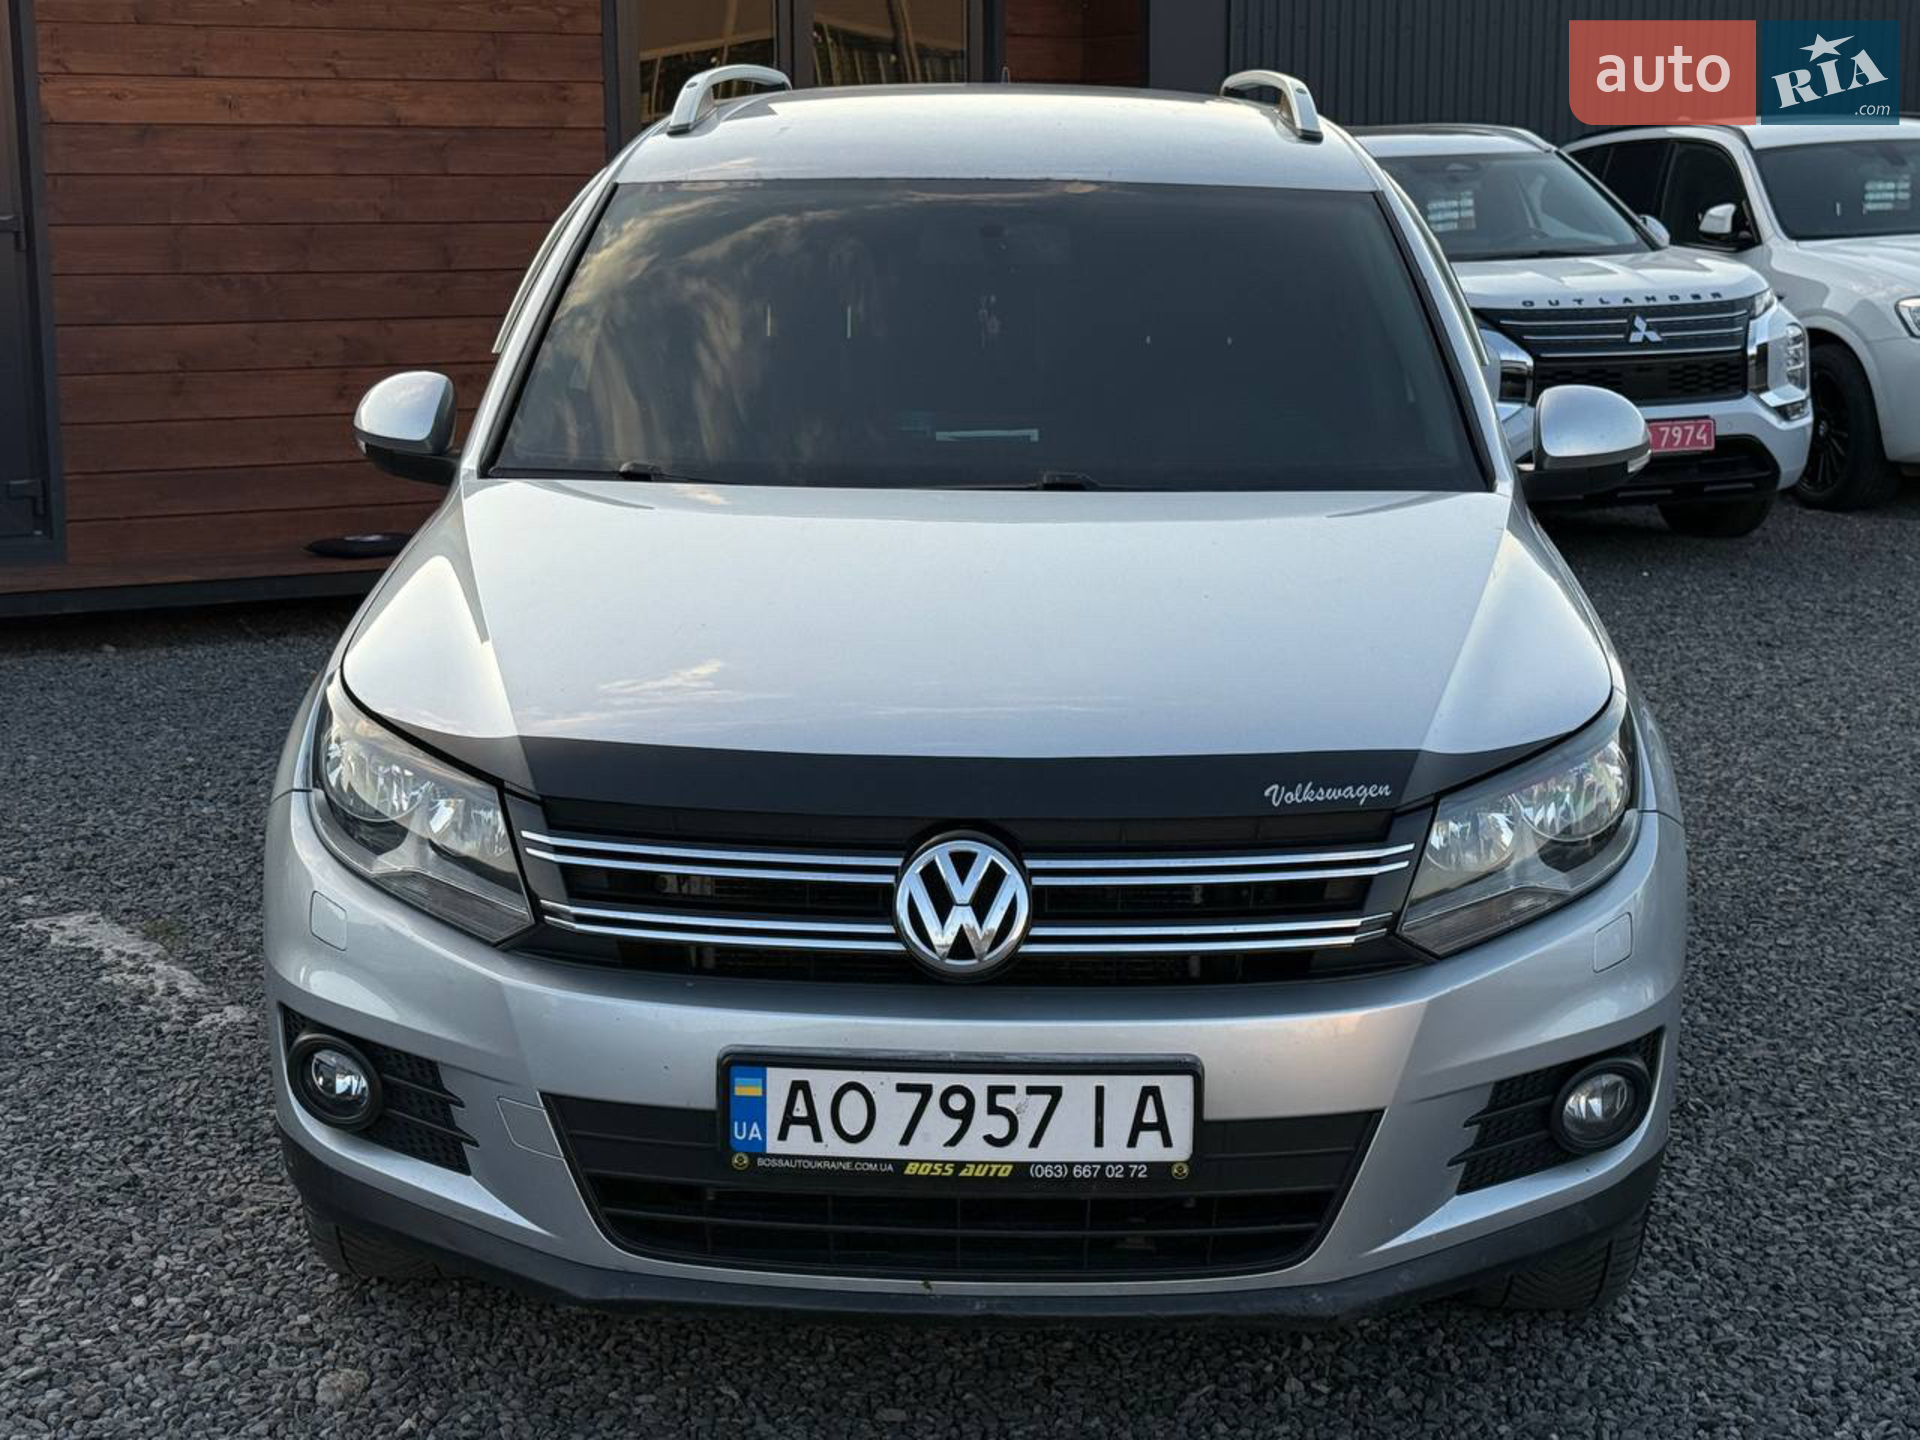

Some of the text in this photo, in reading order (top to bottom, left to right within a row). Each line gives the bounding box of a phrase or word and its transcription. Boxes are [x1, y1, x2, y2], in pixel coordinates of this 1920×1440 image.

[1521, 291, 1723, 308] OUTLANDER
[1658, 424, 1708, 448] 7974
[1263, 780, 1392, 807] Volkswagen
[776, 1079, 1174, 1149] AO 7957 IA
[733, 1121, 763, 1142] UA
[756, 1157, 894, 1173] BOSSAUTOUKRAINE.COM.UA
[903, 1162, 1014, 1178] BOSS AUTO
[1029, 1163, 1148, 1178] (063) 667 02 72
